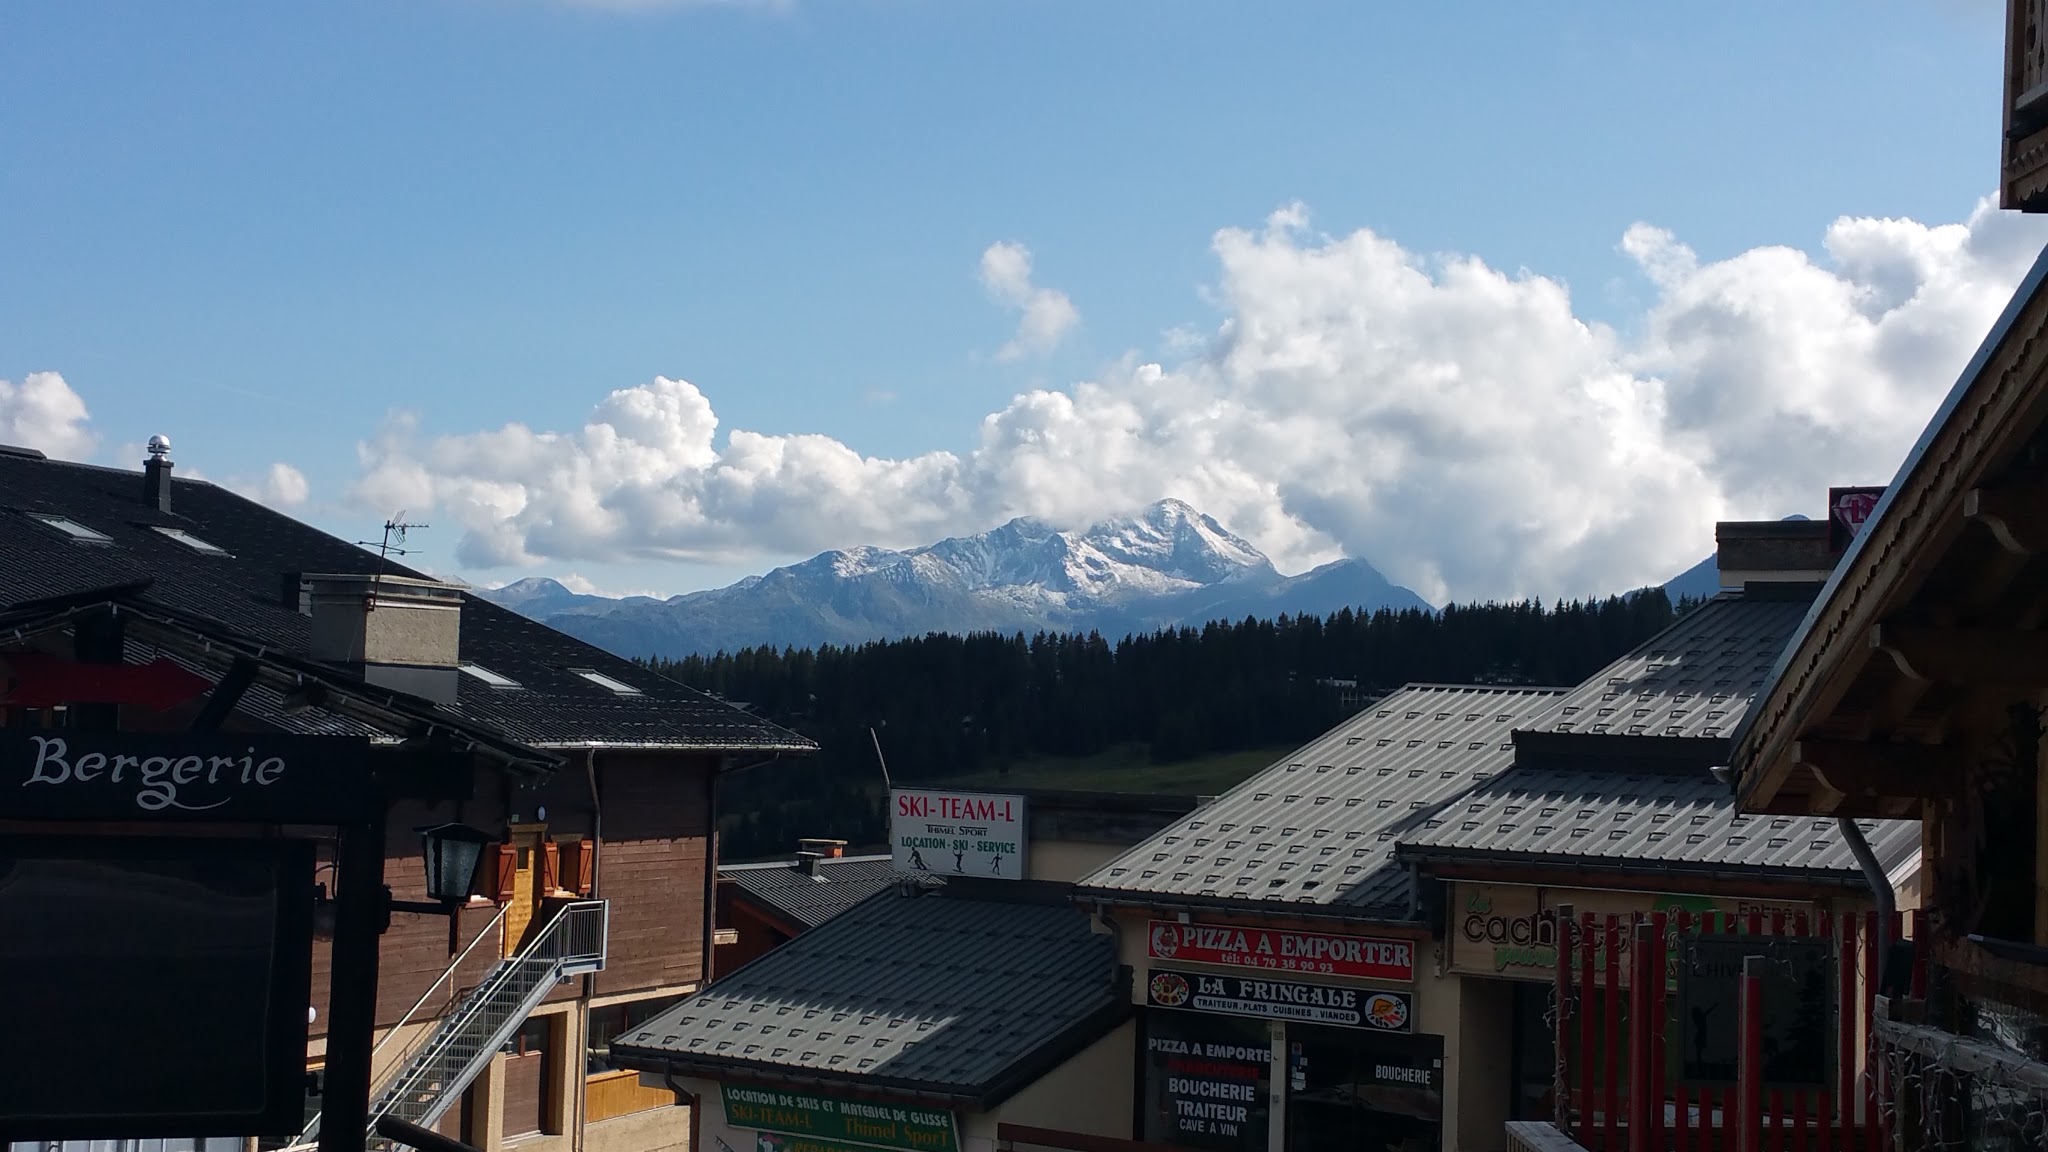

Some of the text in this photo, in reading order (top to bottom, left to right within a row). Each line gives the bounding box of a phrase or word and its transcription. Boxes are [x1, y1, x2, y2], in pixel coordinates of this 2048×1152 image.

[22, 735, 285, 811] Bergerie
[899, 796, 1014, 822] SKI-TEAM-L
[901, 836, 946, 850] LOCATION
[952, 839, 969, 851] SKI
[976, 841, 1016, 854] SERVICE
[1182, 926, 1411, 968] PIZZA A EMPORTER
[1244, 956, 1258, 967] 04
[1262, 957, 1277, 969] 79
[1300, 961, 1316, 972] 90
[1318, 963, 1334, 974] 93
[1198, 976, 1357, 1009] LA FRINGALE
[1273, 1006, 1312, 1017] CUISINES
[1148, 1038, 1271, 1063] PIZZA A EMPORTE
[1375, 1064, 1432, 1085] BOUCHERIE
[1168, 1077, 1255, 1102] BOUCHERIE
[727, 1088, 777, 1106] LOCATION
[780, 1094, 794, 1107] DE
[822, 1100, 834, 1112] ET
[840, 1102, 892, 1120] MATERIEL
[893, 1108, 907, 1122] DE
[910, 1112, 949, 1127] GLISSE
[1176, 1099, 1248, 1123] TRAITEUR
[1179, 1118, 1238, 1137] CAVE A VIN
